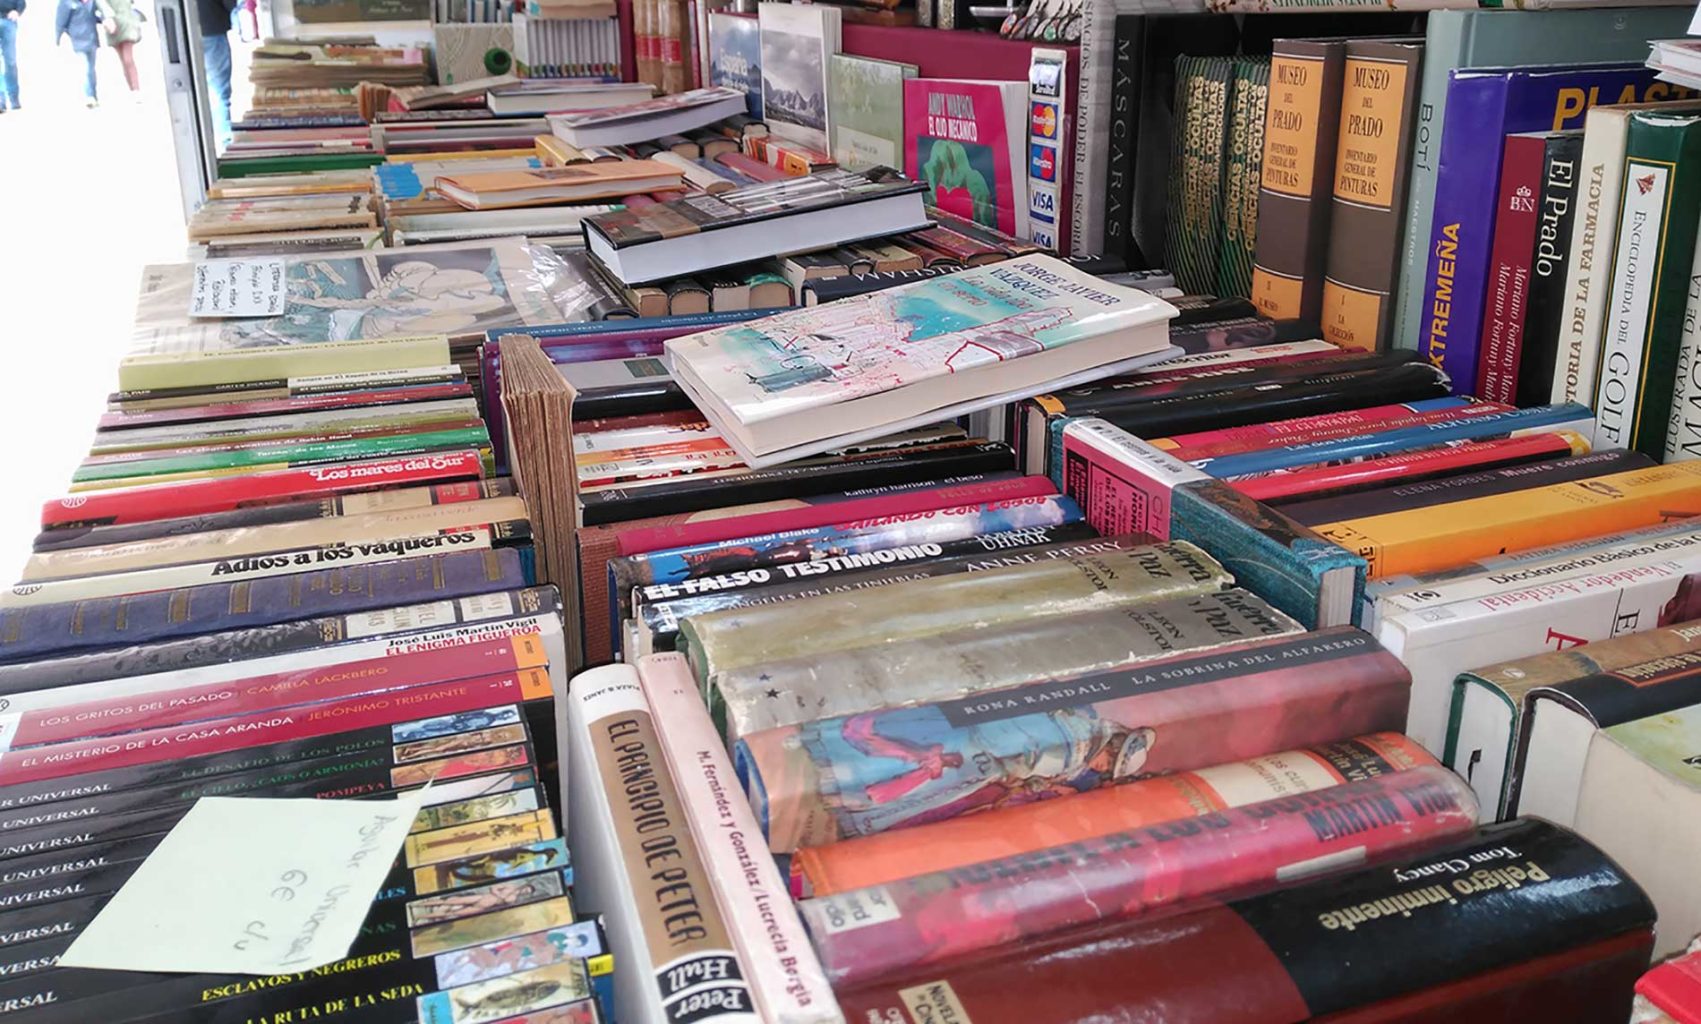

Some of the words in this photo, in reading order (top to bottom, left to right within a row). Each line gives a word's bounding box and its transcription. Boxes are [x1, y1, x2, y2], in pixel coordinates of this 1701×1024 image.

[1081, 1, 1094, 71] SPACIOS
[1277, 63, 1308, 87] MUSEO
[1353, 66, 1390, 91] MUSEO
[1272, 108, 1303, 132] PRADO
[1348, 114, 1383, 138] PRADO
[1265, 167, 1299, 188] PINTURAS
[1339, 175, 1379, 197] PINTURAS
[1549, 159, 1574, 189] El
[1032, 191, 1053, 211] VISA
[1580, 162, 1606, 273] FARMACIA
[1071, 192, 1083, 253] ESCORIA
[1535, 191, 1569, 277] Prado
[1619, 210, 1647, 316] ENCICLOPEDIA
[1012, 262, 1063, 287] JORGE
[1060, 280, 1121, 307] JAVIER
[1428, 221, 1462, 370] XTREMEÑA
[1576, 276, 1591, 304] LA
[1572, 306, 1587, 336] DE
[1565, 339, 1584, 407] STORIA
[1666, 344, 1692, 455] ILUSTRADA
[1684, 307, 1697, 336] DE
[1598, 350, 1630, 445] GOLF
[309, 464, 349, 482] Los
[350, 463, 403, 479] mares
[404, 457, 431, 471] del
[431, 453, 464, 470] Sur
[1393, 482, 1441, 498] ELENA
[1498, 463, 1554, 479] Muere
[844, 483, 888, 498] kathryn
[890, 478, 936, 492] harrison
[959, 473, 984, 484] beso
[292, 551, 313, 565] a
[315, 541, 355, 561] los
[355, 530, 477, 560] vaqueros
[719, 532, 777, 548] Michael
[779, 527, 820, 541] Blake
[643, 582, 679, 601] EL
[679, 567, 771, 594] FALSO
[776, 542, 943, 580] TESTIMONIO
[965, 552, 1042, 574] ANNE
[1045, 539, 1123, 561] PERRY
[1488, 556, 1597, 586] Diccionario
[1654, 540, 1675, 554] de
[1675, 535, 1696, 548] la
[1584, 564, 1672, 588] Vendedor
[1211, 589, 1280, 635] Guerra
[1478, 579, 1583, 612] Accidental
[423, 631, 453, 642] Luis
[505, 617, 538, 634] Vigil
[1202, 605, 1244, 638] Paz
[385, 647, 400, 657] EL
[401, 637, 467, 655] ENIGMA
[468, 624, 543, 642] FIGUEROA
[964, 698, 1020, 715] RONA
[1025, 681, 1112, 704] RANDALL
[1132, 672, 1158, 686] LA
[1161, 657, 1237, 680] SOBRINA
[1243, 649, 1276, 666] DEL
[1282, 636, 1367, 660] ALFARERO
[40, 713, 71, 728] LOS
[75, 704, 134, 721] GRITOS
[138, 701, 165, 714] DEL
[168, 690, 233, 708] PASADO
[246, 678, 309, 697] CAMILLA
[21, 757, 38, 768] EL
[43, 744, 121, 765] MISTERIO
[125, 739, 147, 752] DE
[151, 736, 170, 747] LA
[174, 726, 221, 744] CASA
[223, 715, 294, 737] ARANDA
[393, 685, 470, 709] TRISTANTE
[607, 718, 638, 744] EL
[18, 782, 112, 806] UNIVERSAL
[616, 740, 671, 838] PRINCIPIO
[2, 805, 101, 830] UNIVERSAL
[641, 830, 682, 869] DE
[1470, 844, 1524, 865] Tom
[2, 856, 109, 884] UNIVERSAL
[1394, 853, 1472, 884] Clancy
[1452, 860, 1551, 897] Peligro
[652, 859, 708, 947] PETER
[1317, 886, 1450, 932] inminente
[0, 920, 75, 944] VERSAL
[201, 973, 292, 1003] ESCLAVOS
[310, 948, 401, 980] NEGREROS
[666, 958, 731, 993] Hull
[779, 951, 812, 1009] Borgia
[247, 1009, 271, 1024] LA
[274, 1001, 320, 1024] RUTA
[324, 997, 351, 1016] DE
[354, 991, 376, 1010] LA
[380, 981, 425, 1002] SEDA
[673, 990, 745, 1020] Peter
